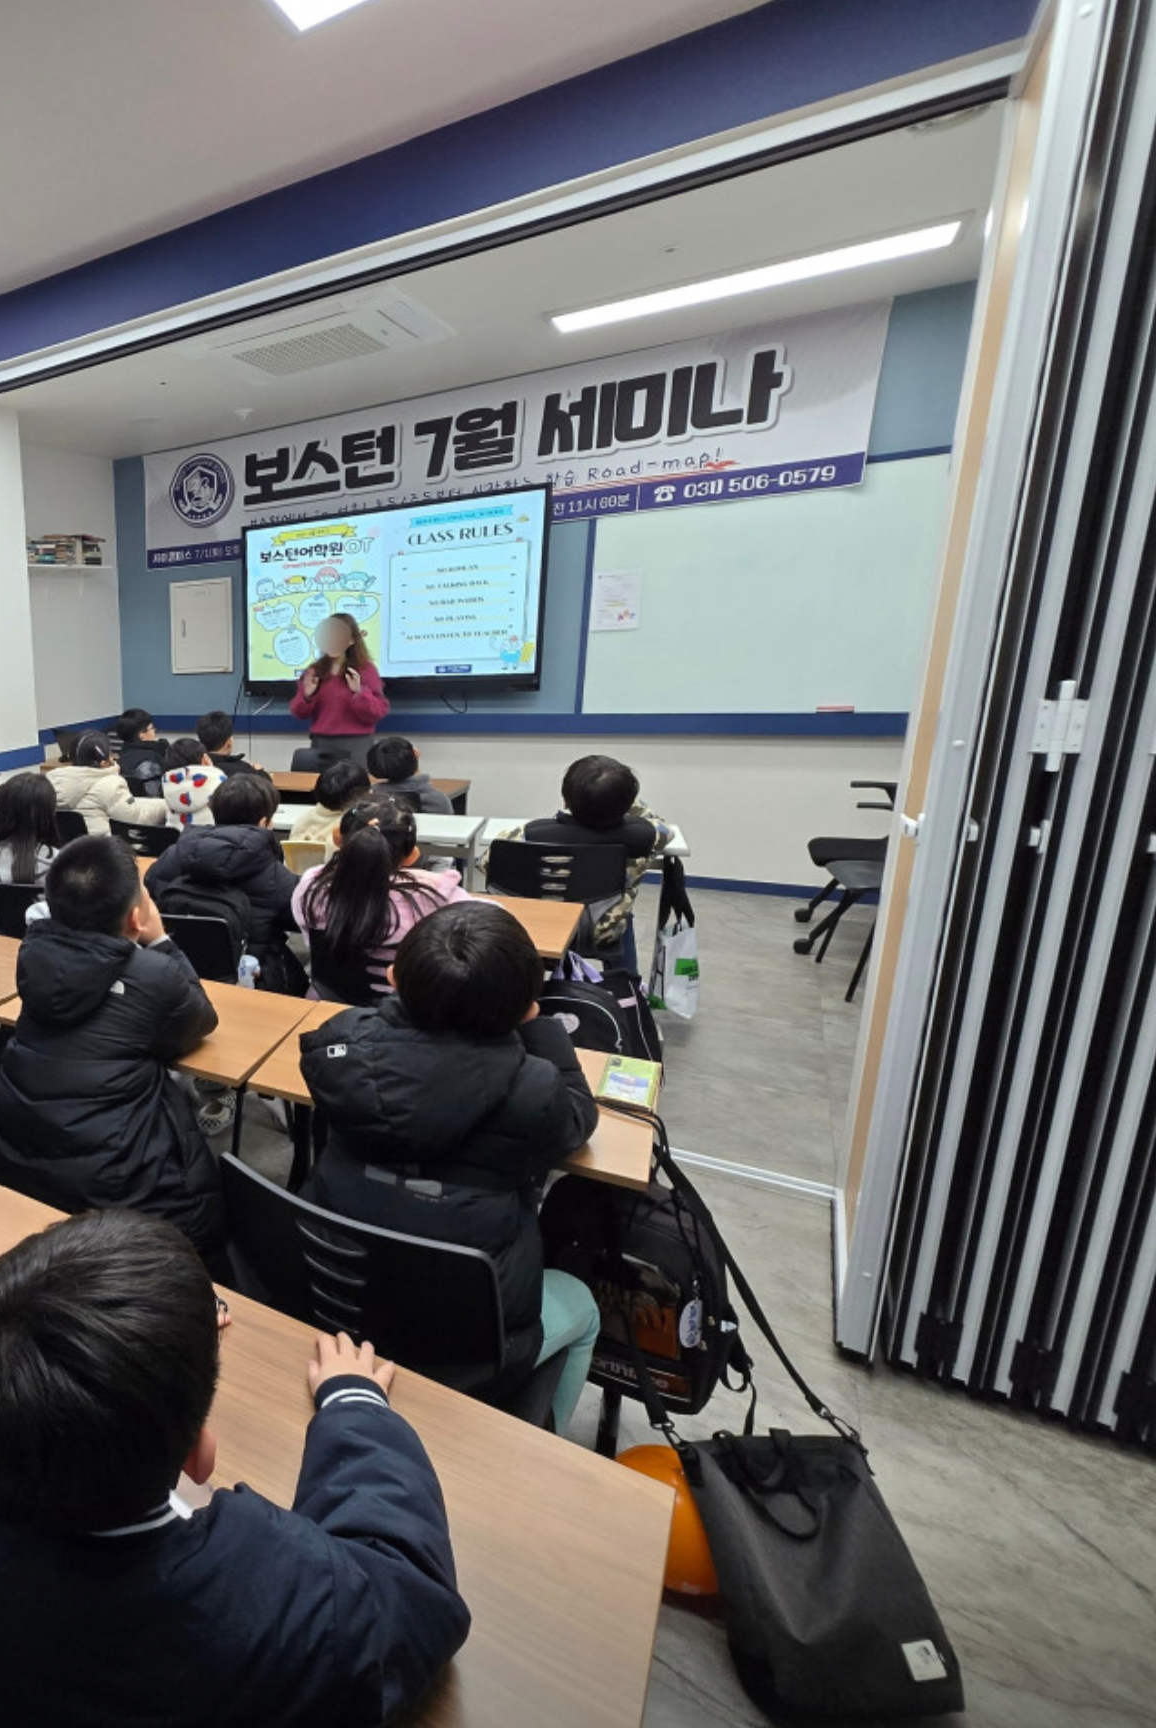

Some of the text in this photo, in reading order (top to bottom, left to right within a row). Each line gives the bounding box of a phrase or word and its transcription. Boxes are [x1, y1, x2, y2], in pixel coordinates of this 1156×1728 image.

[243, 424, 396, 506] 보스턴
[412, 400, 517, 478] 7월
[537, 349, 784, 457] 세미나
[588, 447, 724, 480] Road-map!
[728, 465, 836, 493] 506-0579
[407, 522, 514, 546] CLASS RULES
